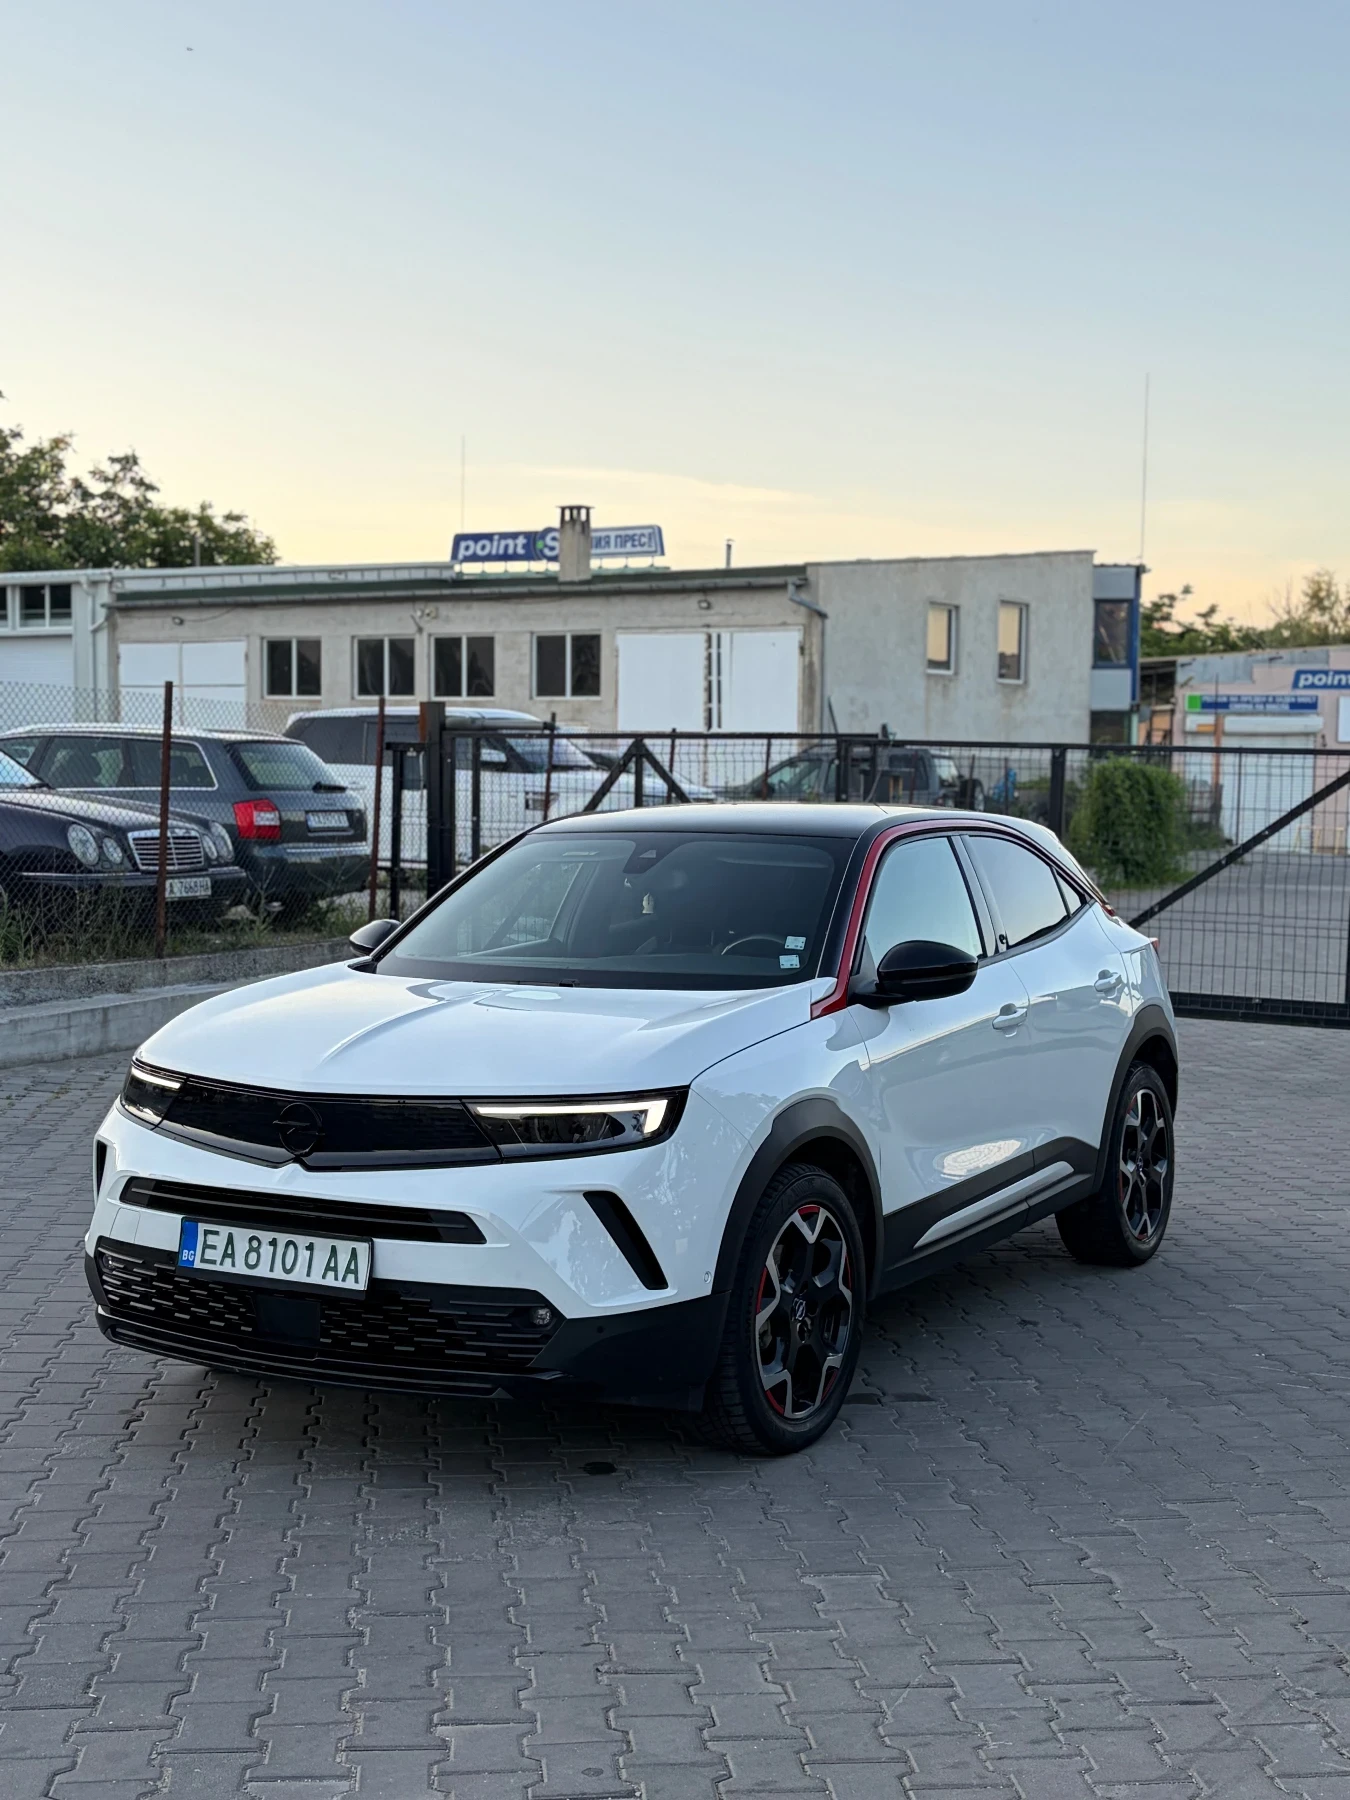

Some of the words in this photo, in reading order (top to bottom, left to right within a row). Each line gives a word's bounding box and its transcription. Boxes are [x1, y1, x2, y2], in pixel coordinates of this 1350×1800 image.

[457, 534, 528, 561] point
[543, 531, 560, 557] S
[182, 1249, 195, 1261] BG
